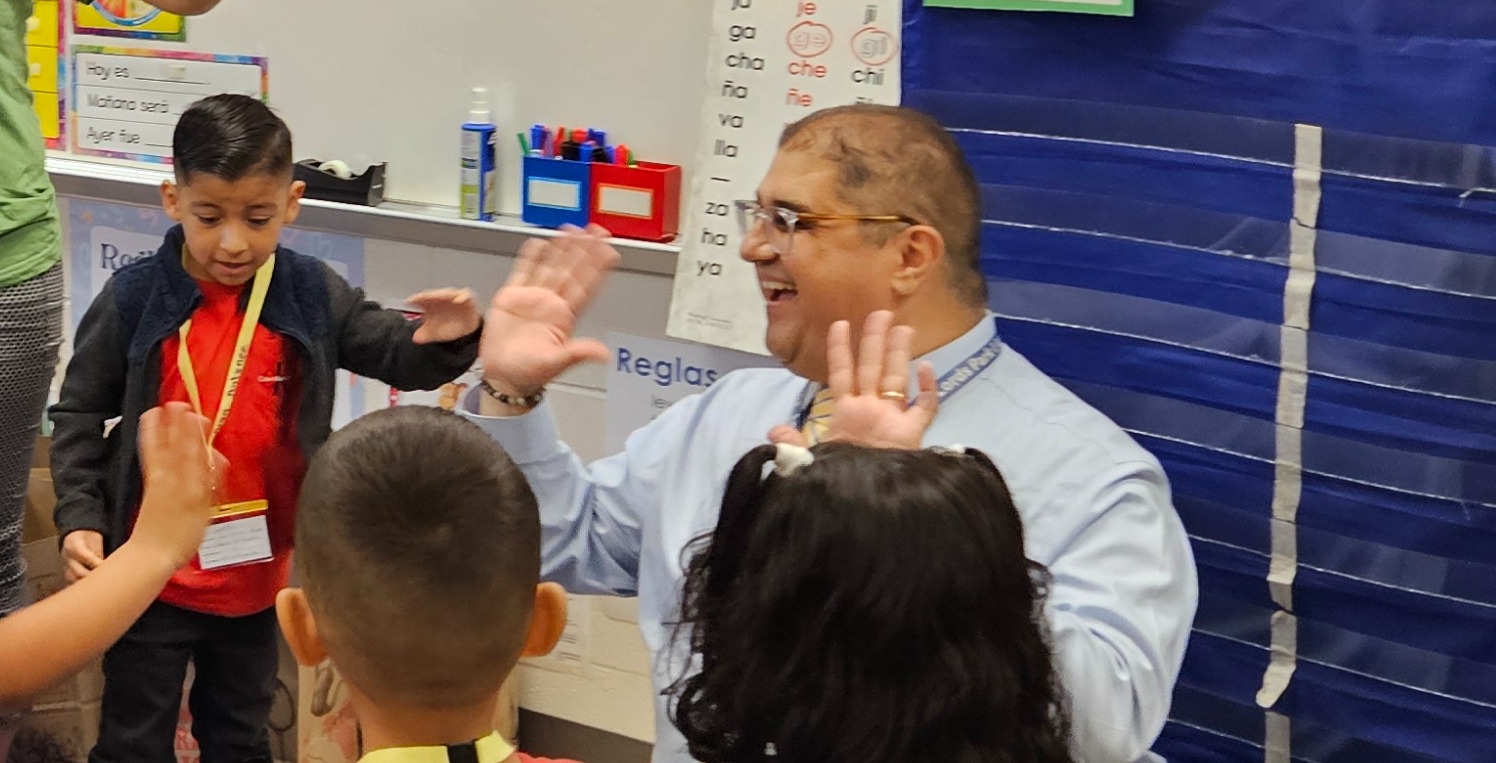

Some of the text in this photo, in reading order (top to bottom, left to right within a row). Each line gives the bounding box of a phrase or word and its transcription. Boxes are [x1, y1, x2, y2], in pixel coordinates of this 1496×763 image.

[796, 0, 817, 17] je
[862, 5, 879, 25] ji
[729, 25, 888, 59] ga ge gi
[86, 63, 130, 80] Hoy es
[725, 52, 886, 86] cha che chi
[87, 93, 137, 111] Mañana
[721, 80, 813, 107] ña ñe
[718, 113, 744, 128] va
[86, 127, 141, 144] Ayer fue
[713, 139, 738, 157] lla
[704, 202, 729, 216] za
[701, 227, 728, 247] ha
[696, 260, 723, 277] ya
[617, 347, 719, 387] Reglas
